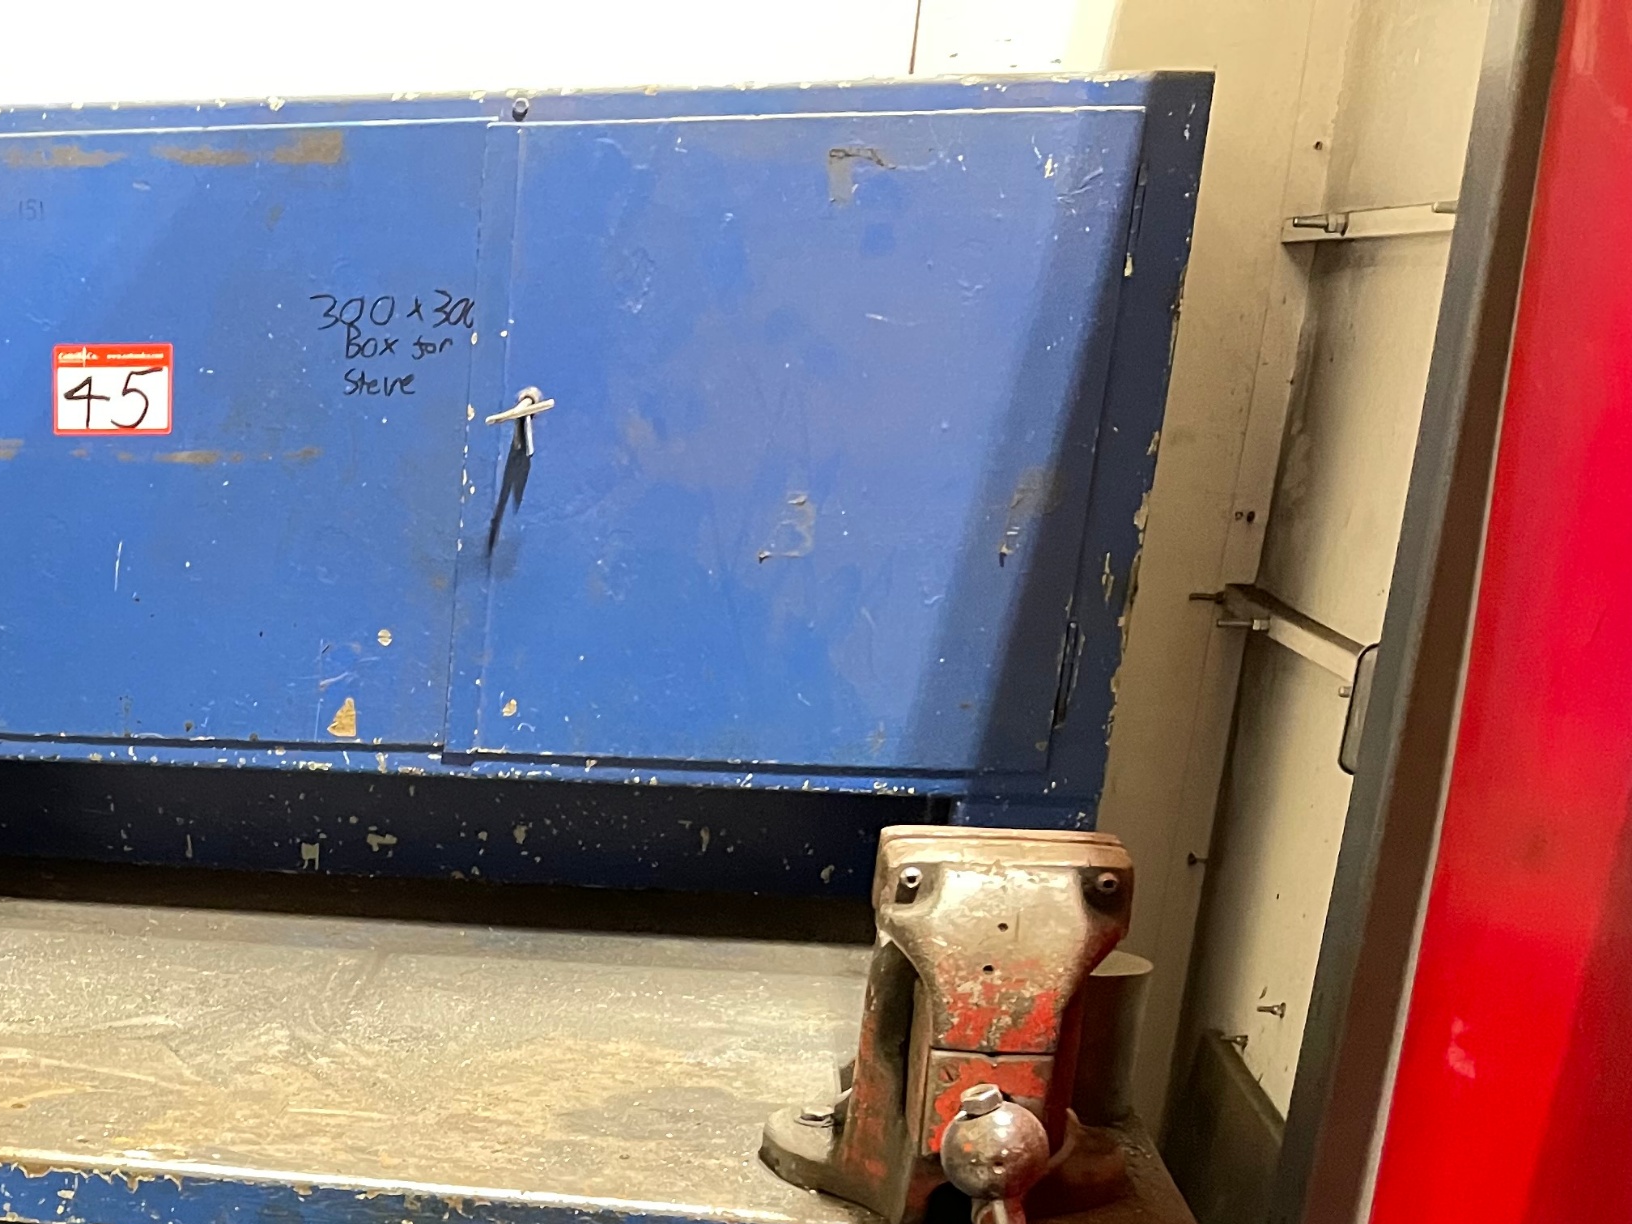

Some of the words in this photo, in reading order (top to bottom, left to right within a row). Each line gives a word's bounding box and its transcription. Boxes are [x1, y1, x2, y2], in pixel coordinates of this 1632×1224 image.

[309, 294, 396, 330] 300
[345, 323, 400, 360] Box
[411, 334, 454, 361] for
[63, 365, 164, 429] 45
[342, 367, 416, 397] Steve
